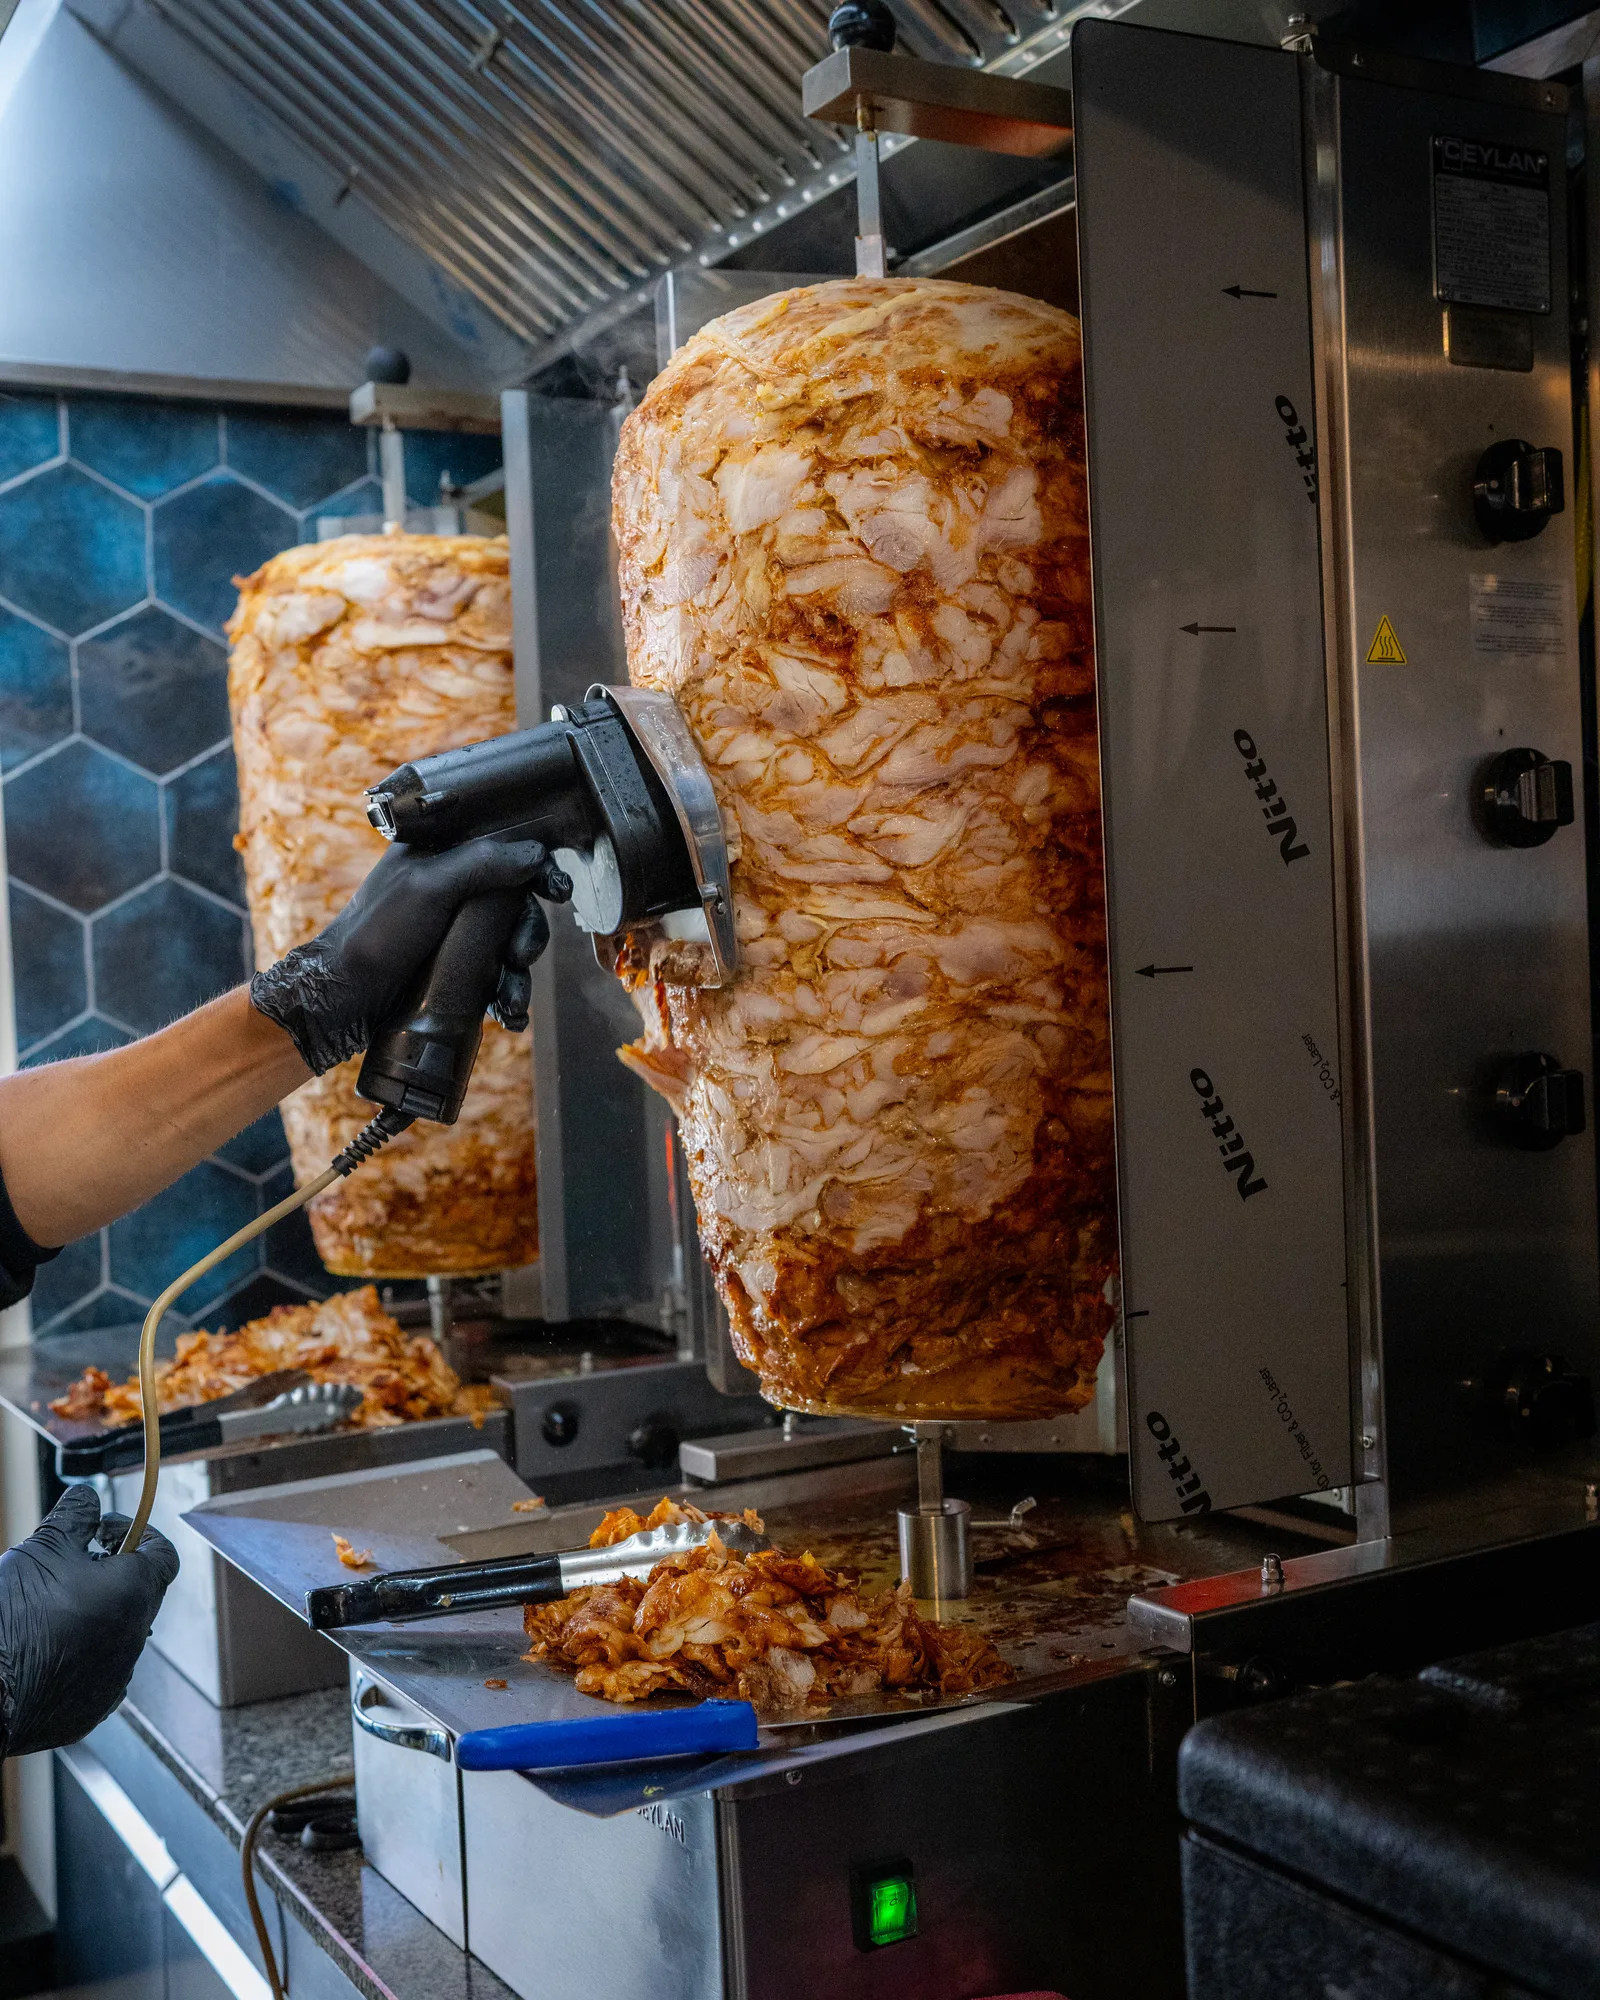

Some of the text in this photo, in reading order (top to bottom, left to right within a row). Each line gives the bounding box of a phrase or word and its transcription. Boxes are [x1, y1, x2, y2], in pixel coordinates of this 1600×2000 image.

[1443, 138, 1541, 174] CEYLAN
[1233, 728, 1311, 867] Nitto
[1301, 1033, 1323, 1067] Laser
[1190, 1067, 1269, 1203] Nitto
[1258, 1366, 1281, 1401] Laser
[1288, 1419, 1299, 1433] &
[1293, 1431, 1314, 1461] Fiber
[1310, 1458, 1323, 1476] for
